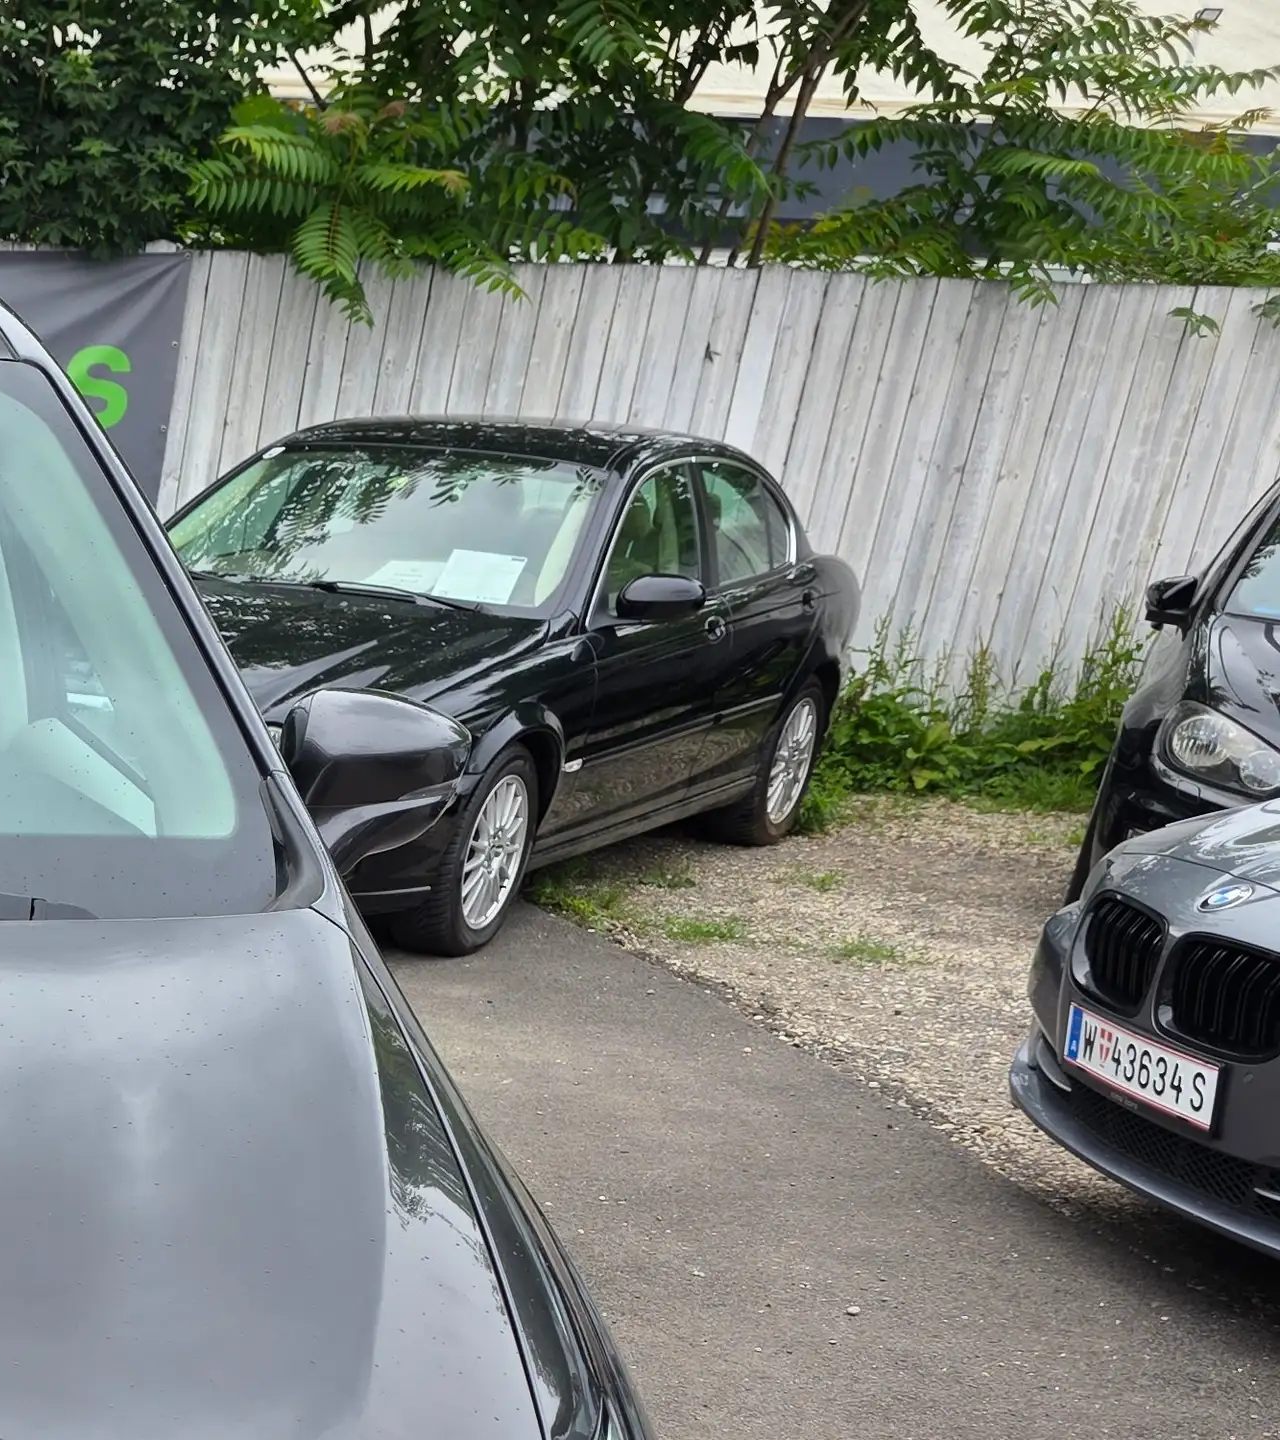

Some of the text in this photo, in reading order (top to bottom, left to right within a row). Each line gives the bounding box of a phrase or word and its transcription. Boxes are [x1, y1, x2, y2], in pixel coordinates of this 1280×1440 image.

[1082, 1019, 1098, 1063] W
[1111, 1036, 1183, 1105] 43634
[1188, 1071, 1207, 1113] S
